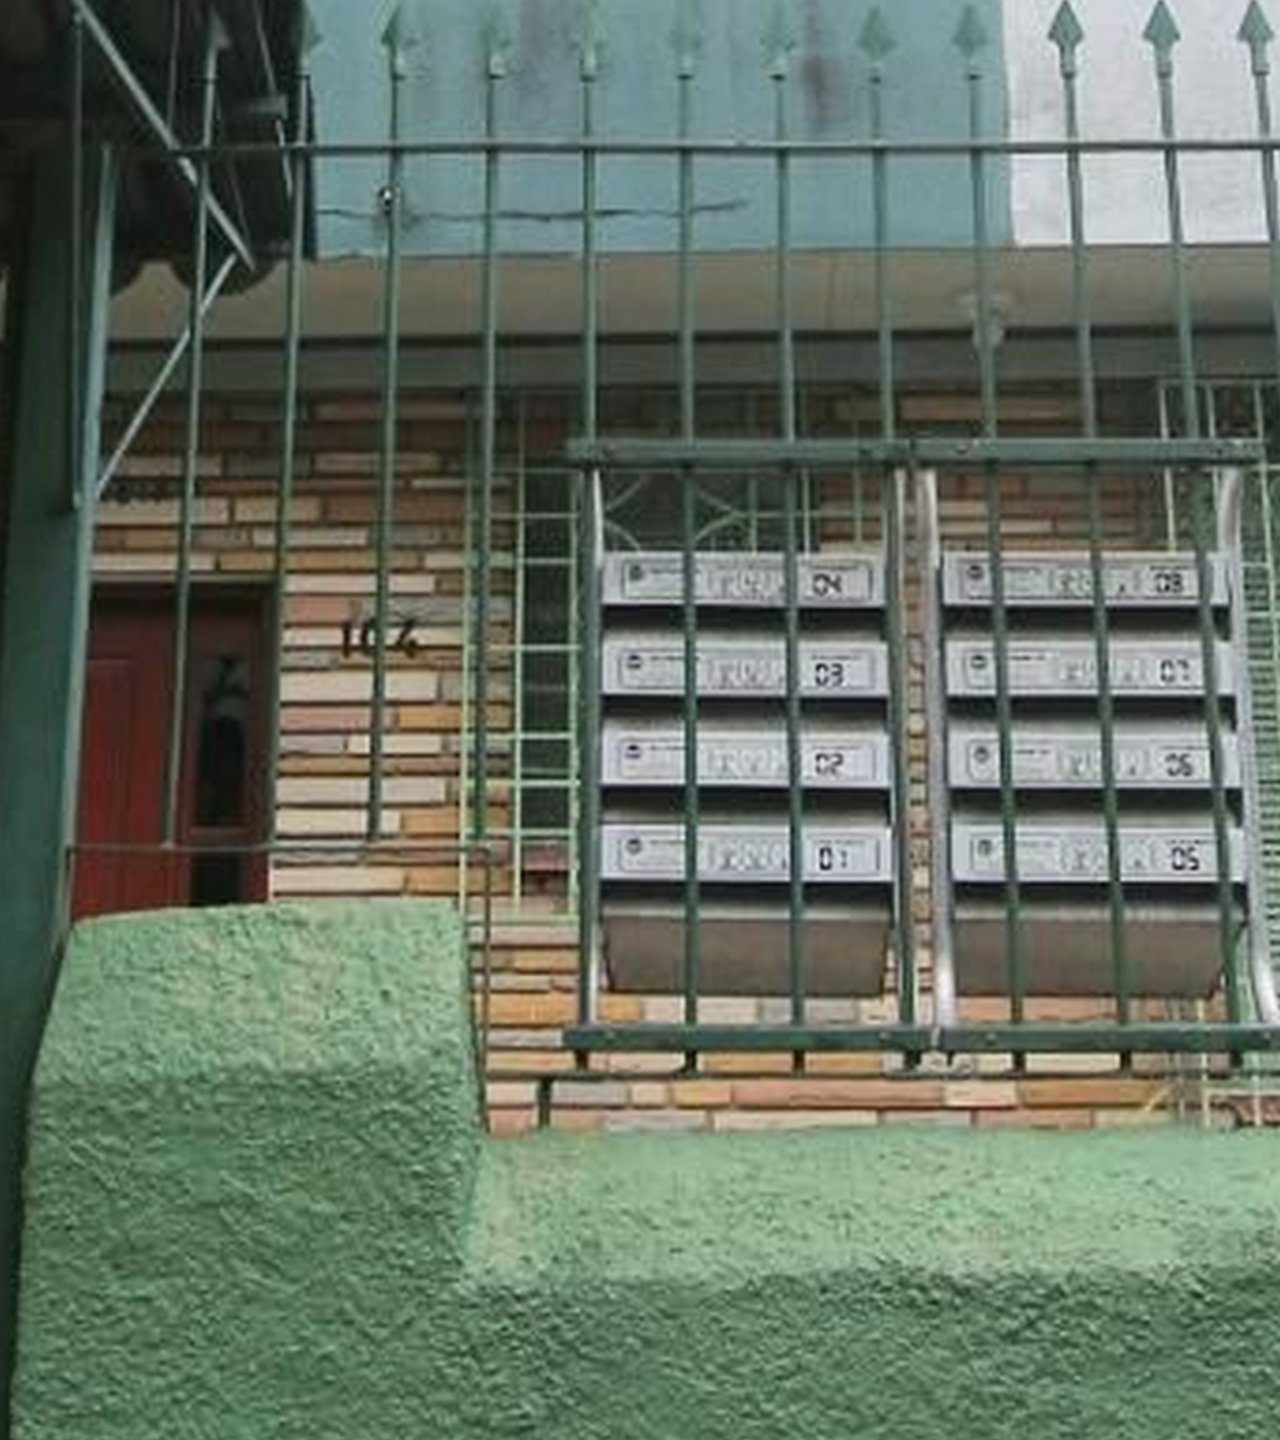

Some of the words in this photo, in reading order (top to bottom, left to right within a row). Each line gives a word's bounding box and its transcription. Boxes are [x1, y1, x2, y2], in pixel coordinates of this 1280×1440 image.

[812, 572, 843, 597] 04
[815, 662, 845, 687] 03
[815, 752, 845, 776] 02
[1171, 847, 1200, 871] 05
